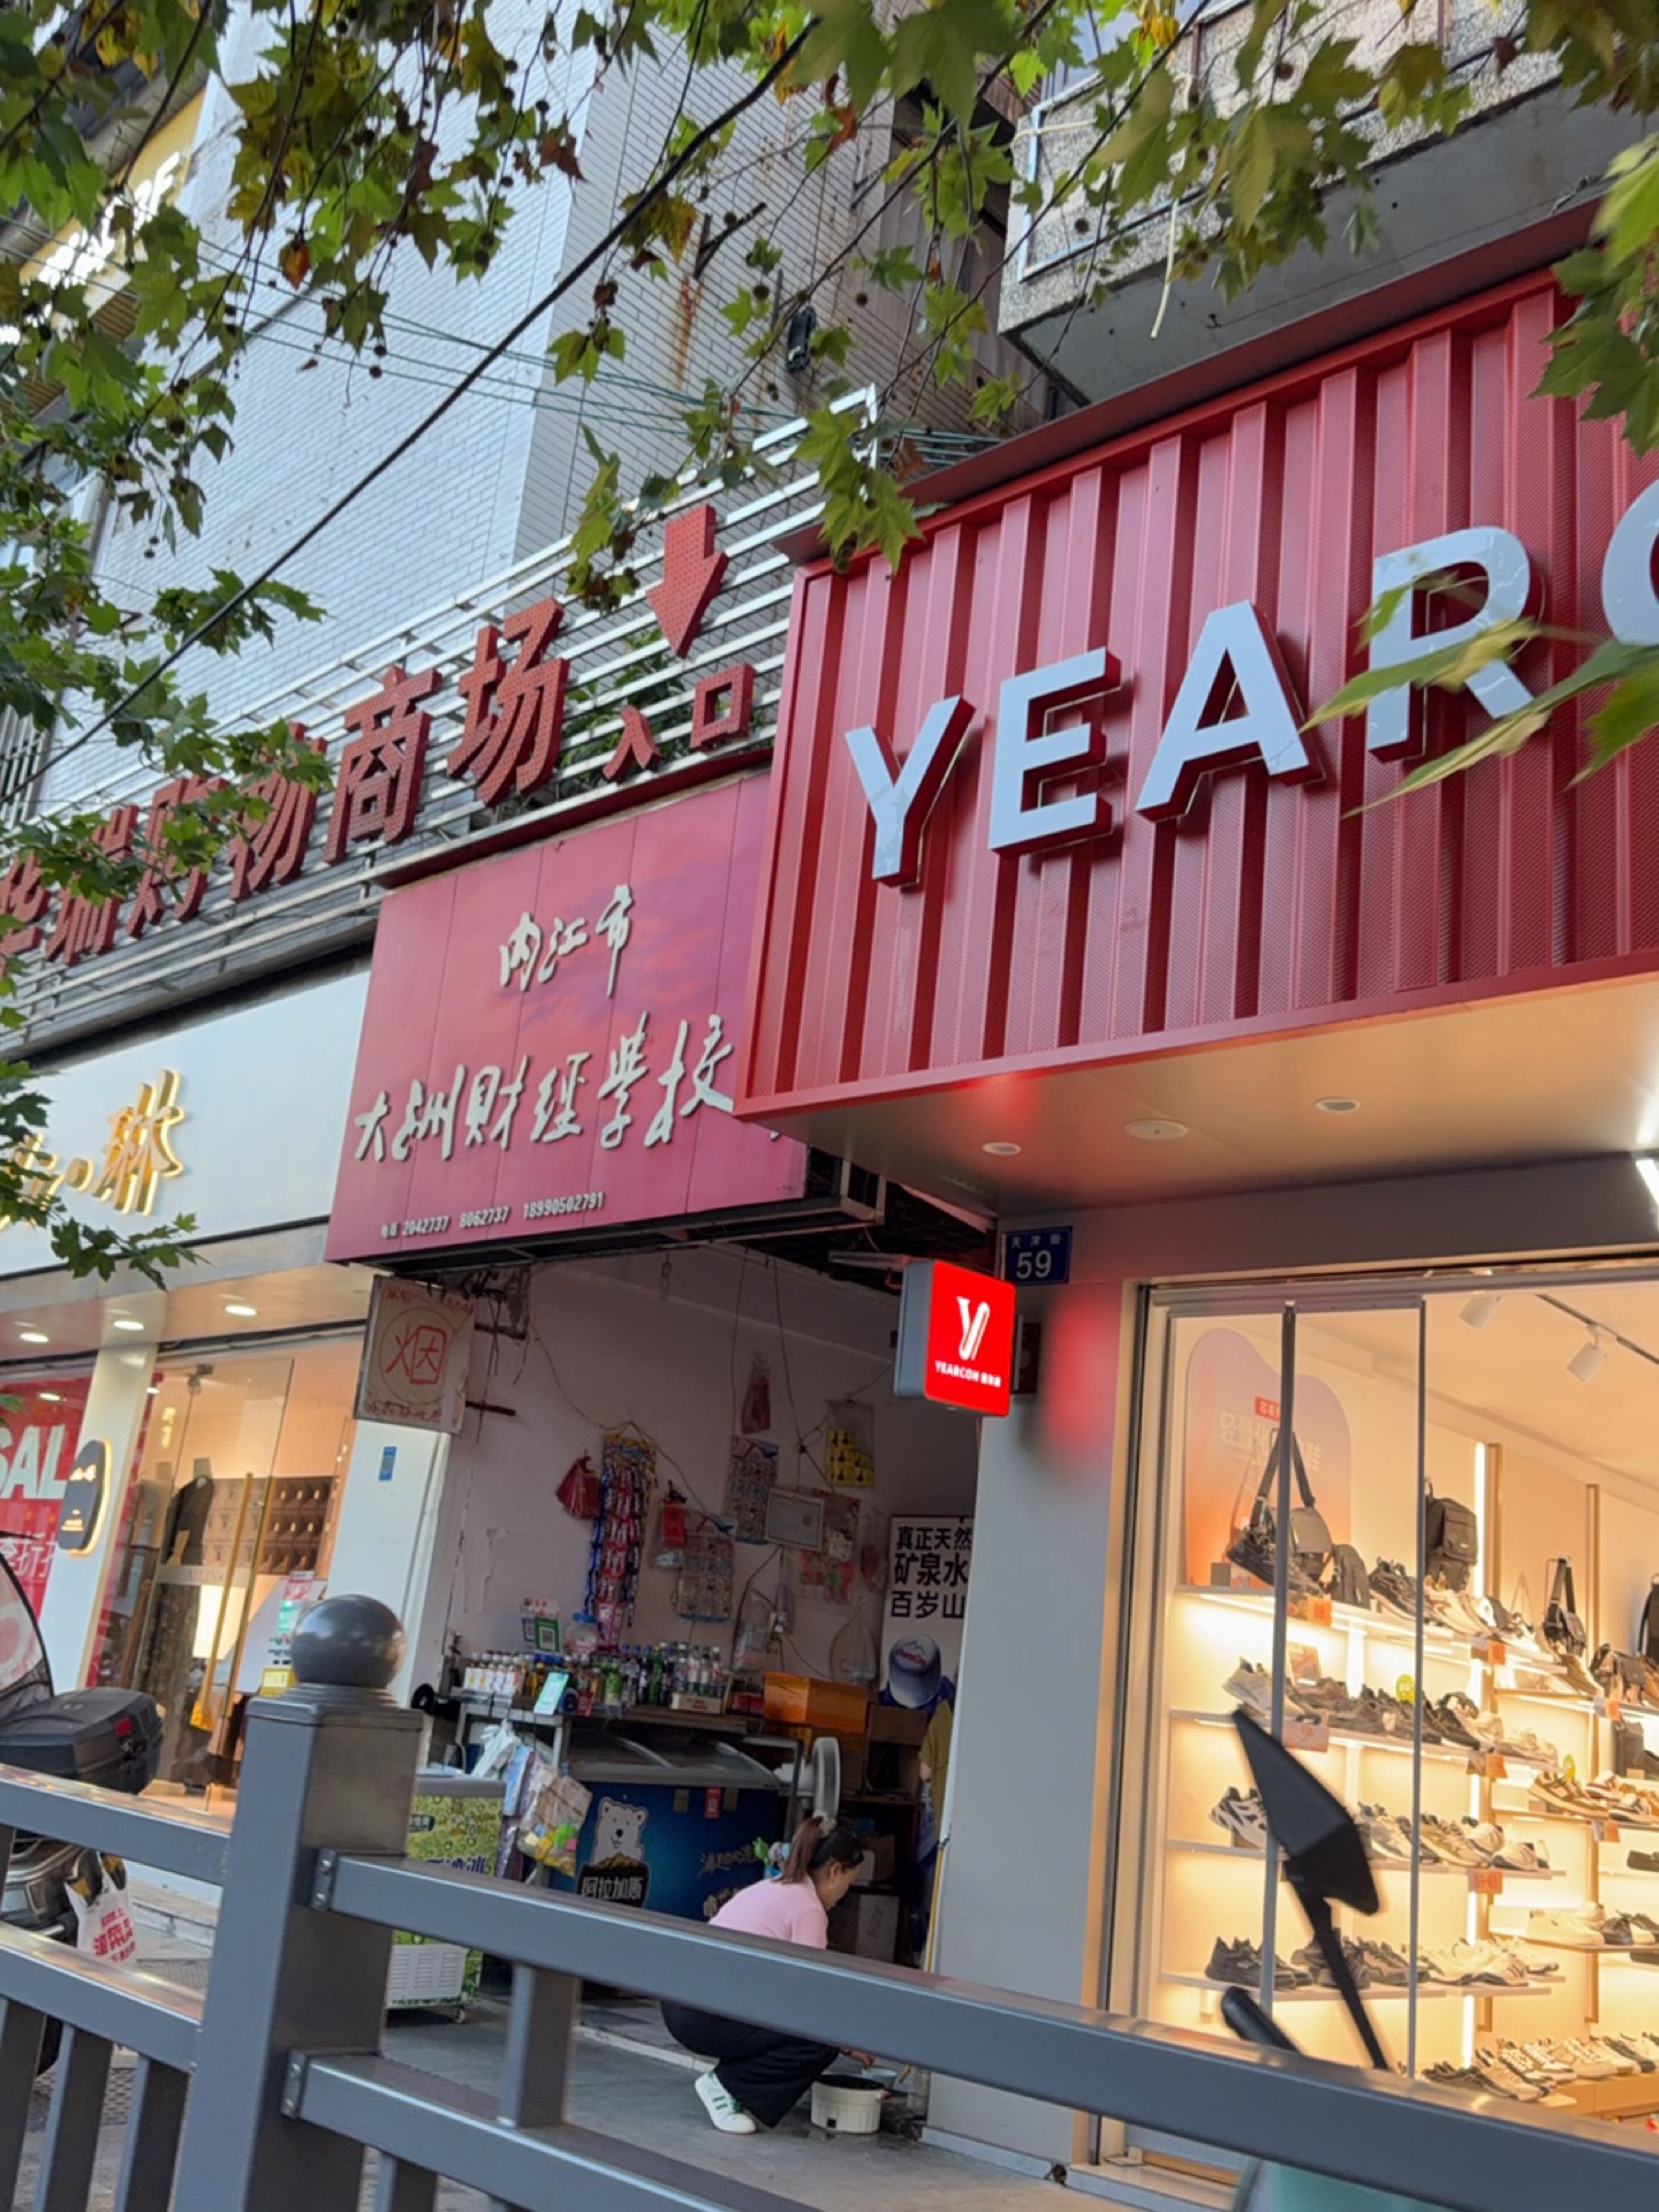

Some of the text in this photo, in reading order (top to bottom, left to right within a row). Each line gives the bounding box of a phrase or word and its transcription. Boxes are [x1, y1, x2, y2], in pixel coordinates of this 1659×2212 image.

[604, 663, 755, 782] 入口
[499, 884, 634, 997] 内江市
[401, 1215, 449, 1236] 2042737
[460, 1206, 508, 1228] 8062737
[524, 1192, 604, 1219] 18990502791
[1016, 1250, 1052, 1279] 59
[385, 1322, 447, 1384] 烟
[934, 1359, 979, 1382] YEARCON
[897, 1527, 972, 1550] 真正天然
[894, 1552, 968, 1587] 矿泉水
[891, 1591, 965, 1619] 百岁山
